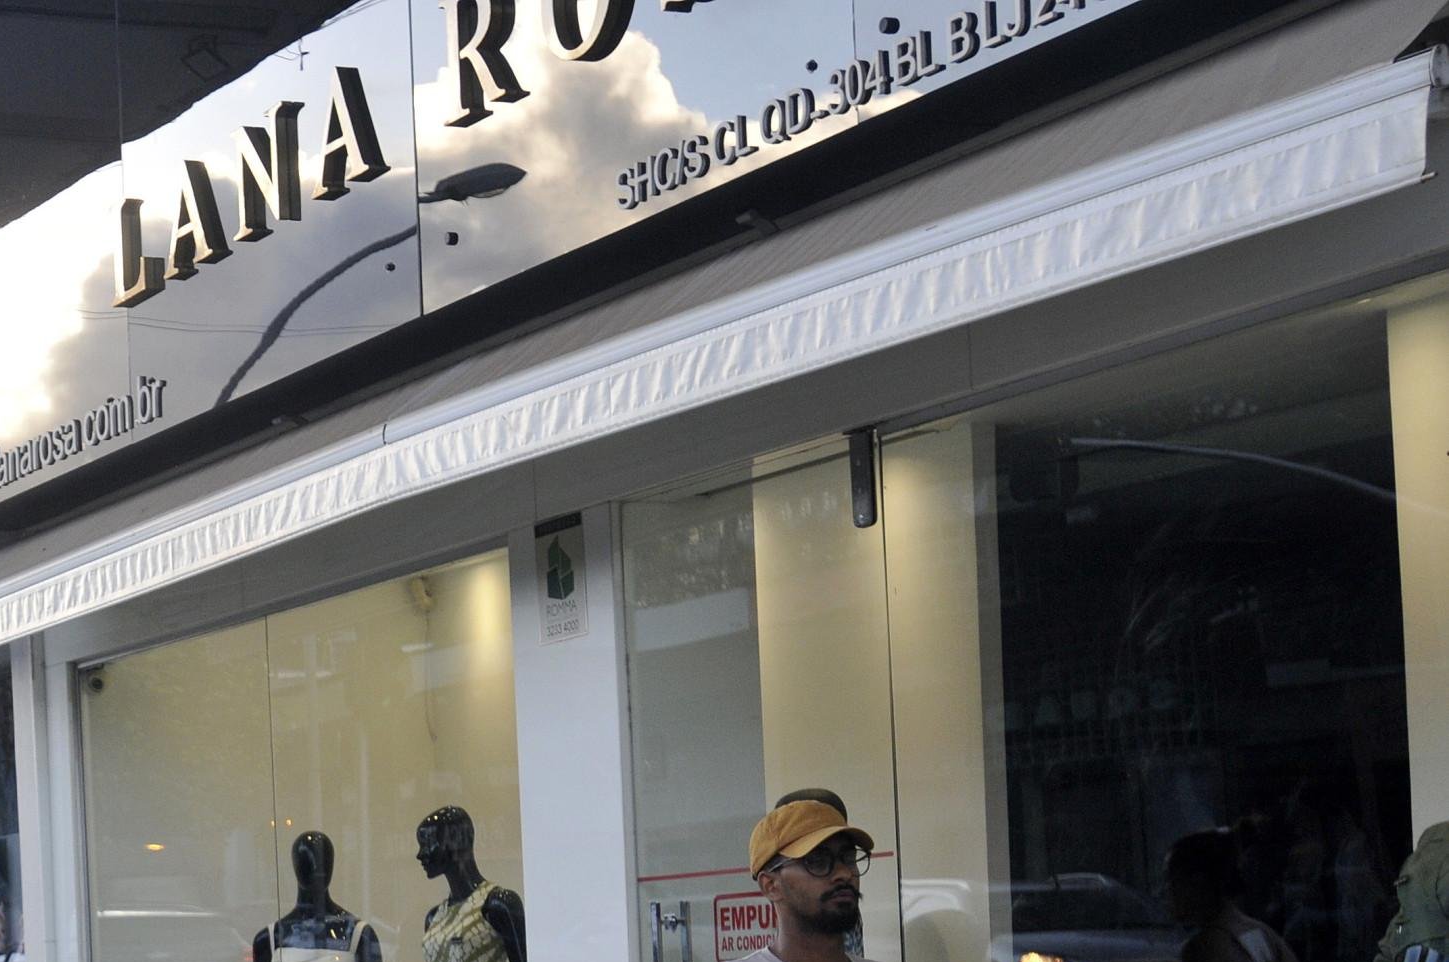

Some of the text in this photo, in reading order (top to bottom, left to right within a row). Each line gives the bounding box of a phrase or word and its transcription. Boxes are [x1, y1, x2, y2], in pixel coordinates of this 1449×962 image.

[714, 115, 758, 166] CL
[893, 30, 946, 87] BL
[113, 66, 391, 308] LANA
[721, 935, 735, 952] AR
